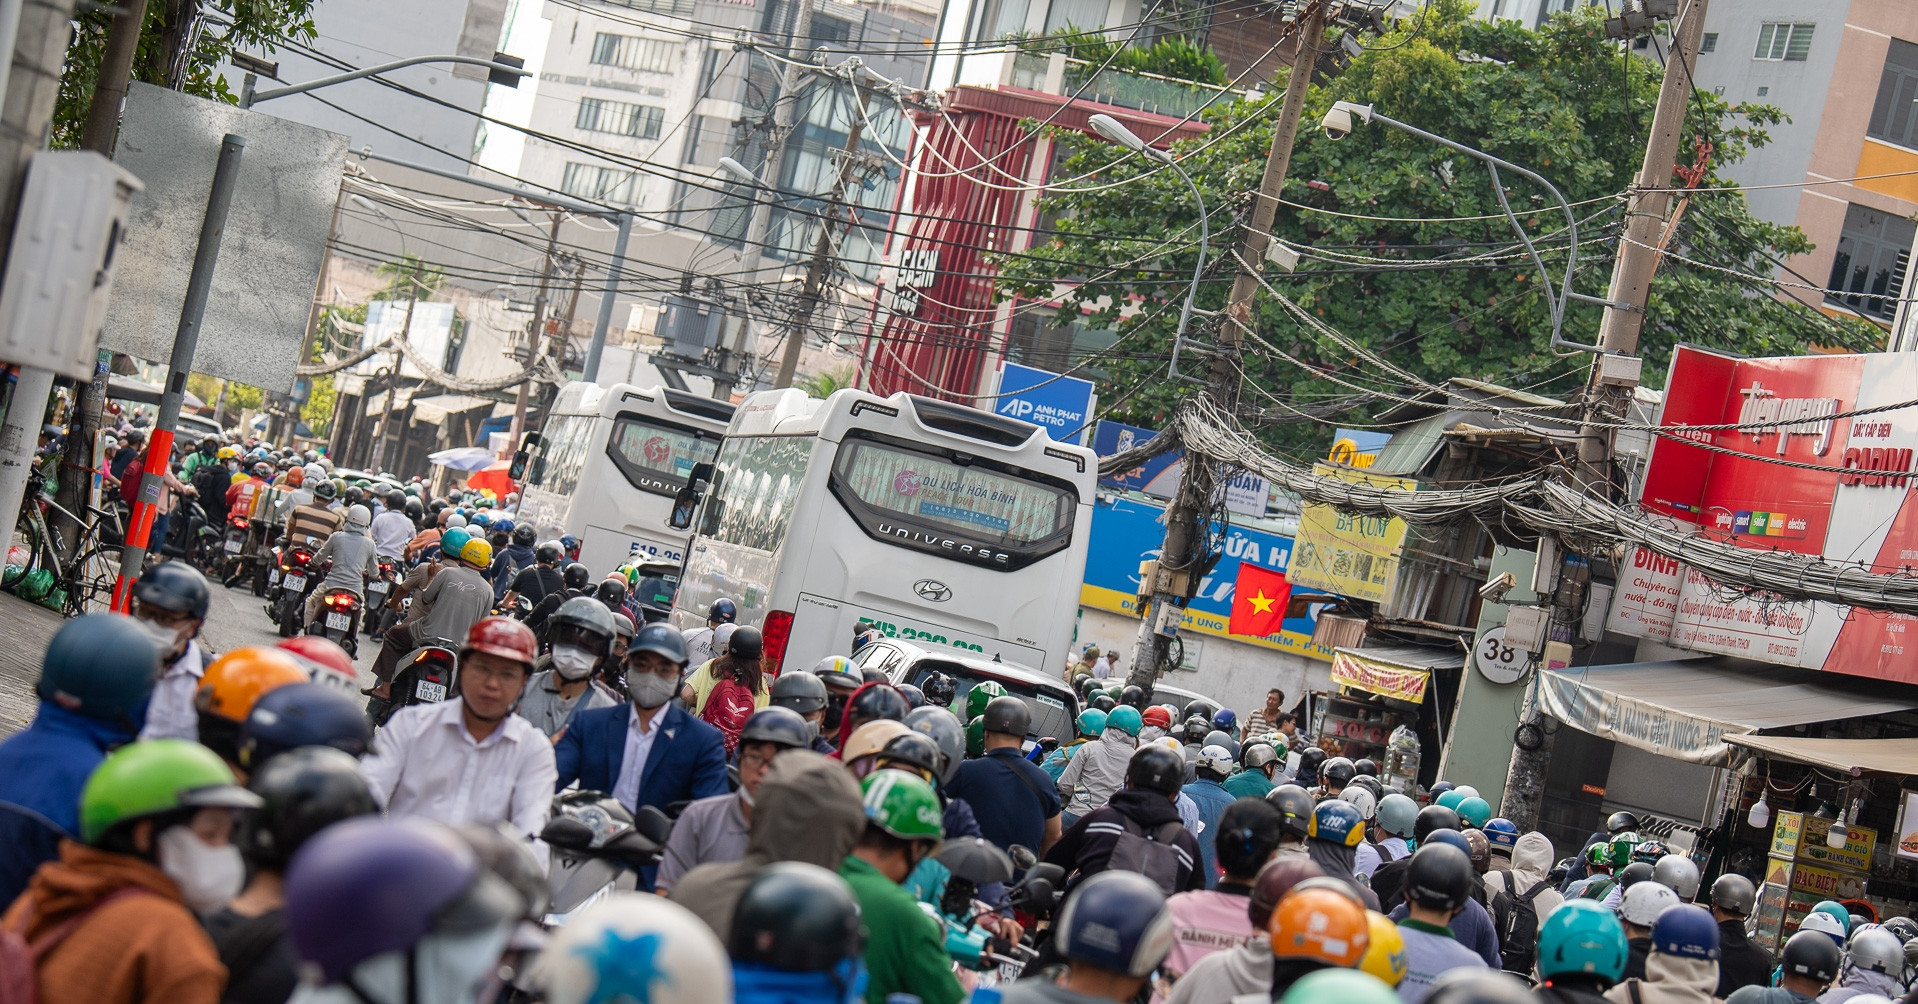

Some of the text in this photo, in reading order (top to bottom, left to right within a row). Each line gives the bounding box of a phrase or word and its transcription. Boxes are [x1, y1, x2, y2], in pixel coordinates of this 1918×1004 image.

[1000, 398, 1082, 421] AP ANH PHAT
[1033, 413, 1065, 427] PETRO
[922, 476, 938, 488] DU
[1736, 514, 1750, 527] smart
[878, 523, 1009, 564] UNIVERSE
[1633, 578, 1666, 593] Chuyên
[1197, 617, 1224, 631] UNG
[1484, 637, 1515, 664] 38
[1794, 868, 1837, 894] ĐẶC BIỆT
